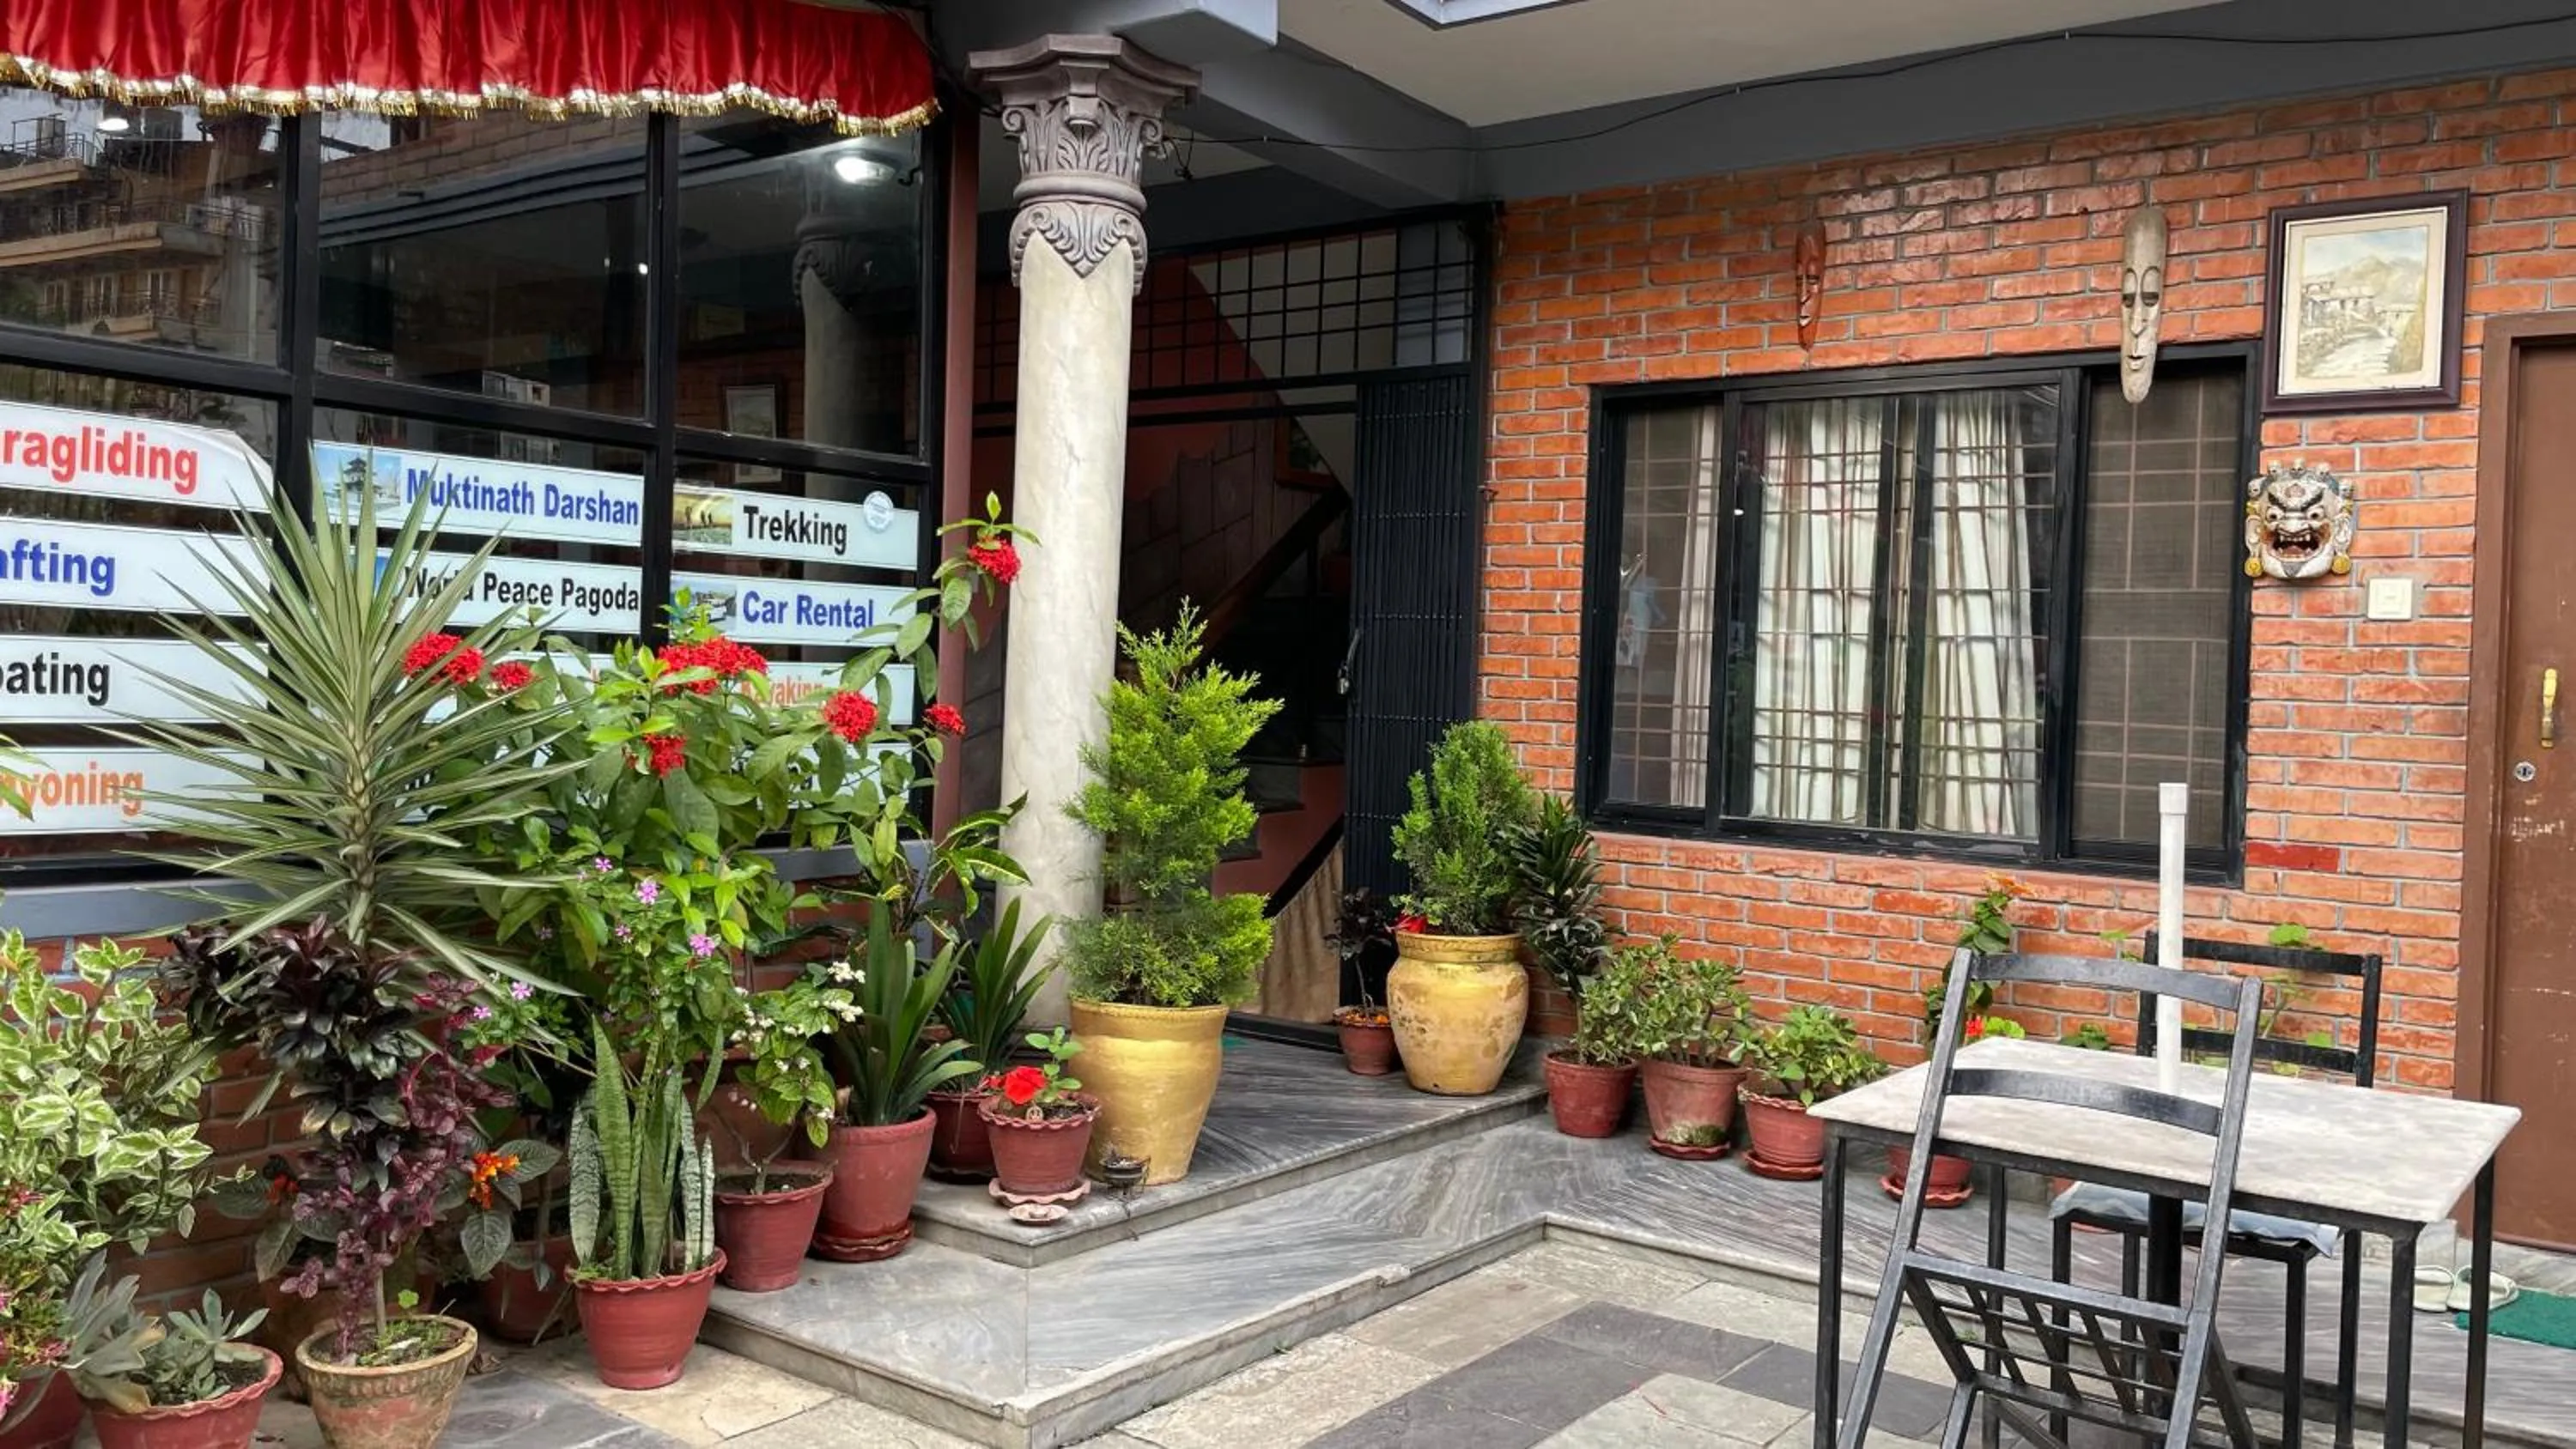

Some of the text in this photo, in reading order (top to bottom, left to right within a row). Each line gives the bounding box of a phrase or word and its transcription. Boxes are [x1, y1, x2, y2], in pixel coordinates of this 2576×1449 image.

[4, 427, 198, 494] ragliding
[407, 468, 639, 525] Muktinath Darshan
[744, 505, 848, 555] Trekking
[483, 572, 552, 607] Peace
[562, 578, 639, 616] Pagoda
[743, 591, 874, 628] Car Rental
[0, 652, 110, 706] ating
